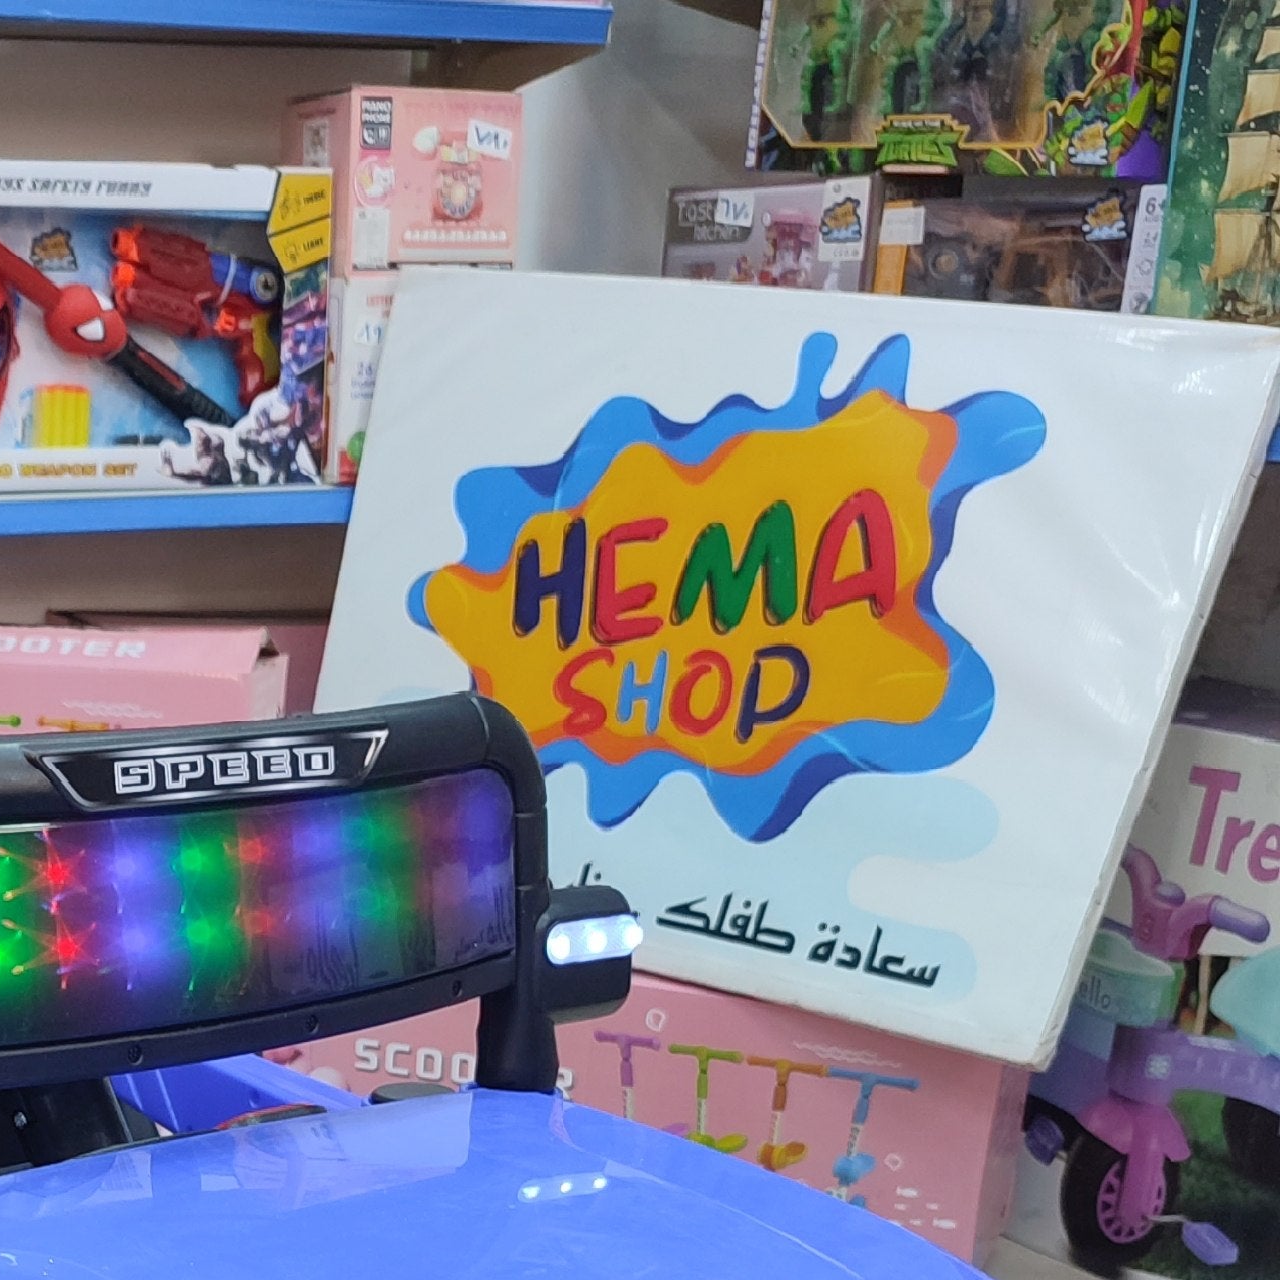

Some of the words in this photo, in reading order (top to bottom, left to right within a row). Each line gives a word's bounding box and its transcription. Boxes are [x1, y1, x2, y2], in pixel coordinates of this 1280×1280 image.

[513, 487, 898, 651] HEMA
[551, 643, 811, 744] SHOP
[113, 745, 336, 795] SPEED
[655, 891, 797, 955] طفلك
[806, 921, 942, 989] سعادة
[1077, 976, 1112, 1010] ello
[353, 1037, 574, 1100] SCOOR
